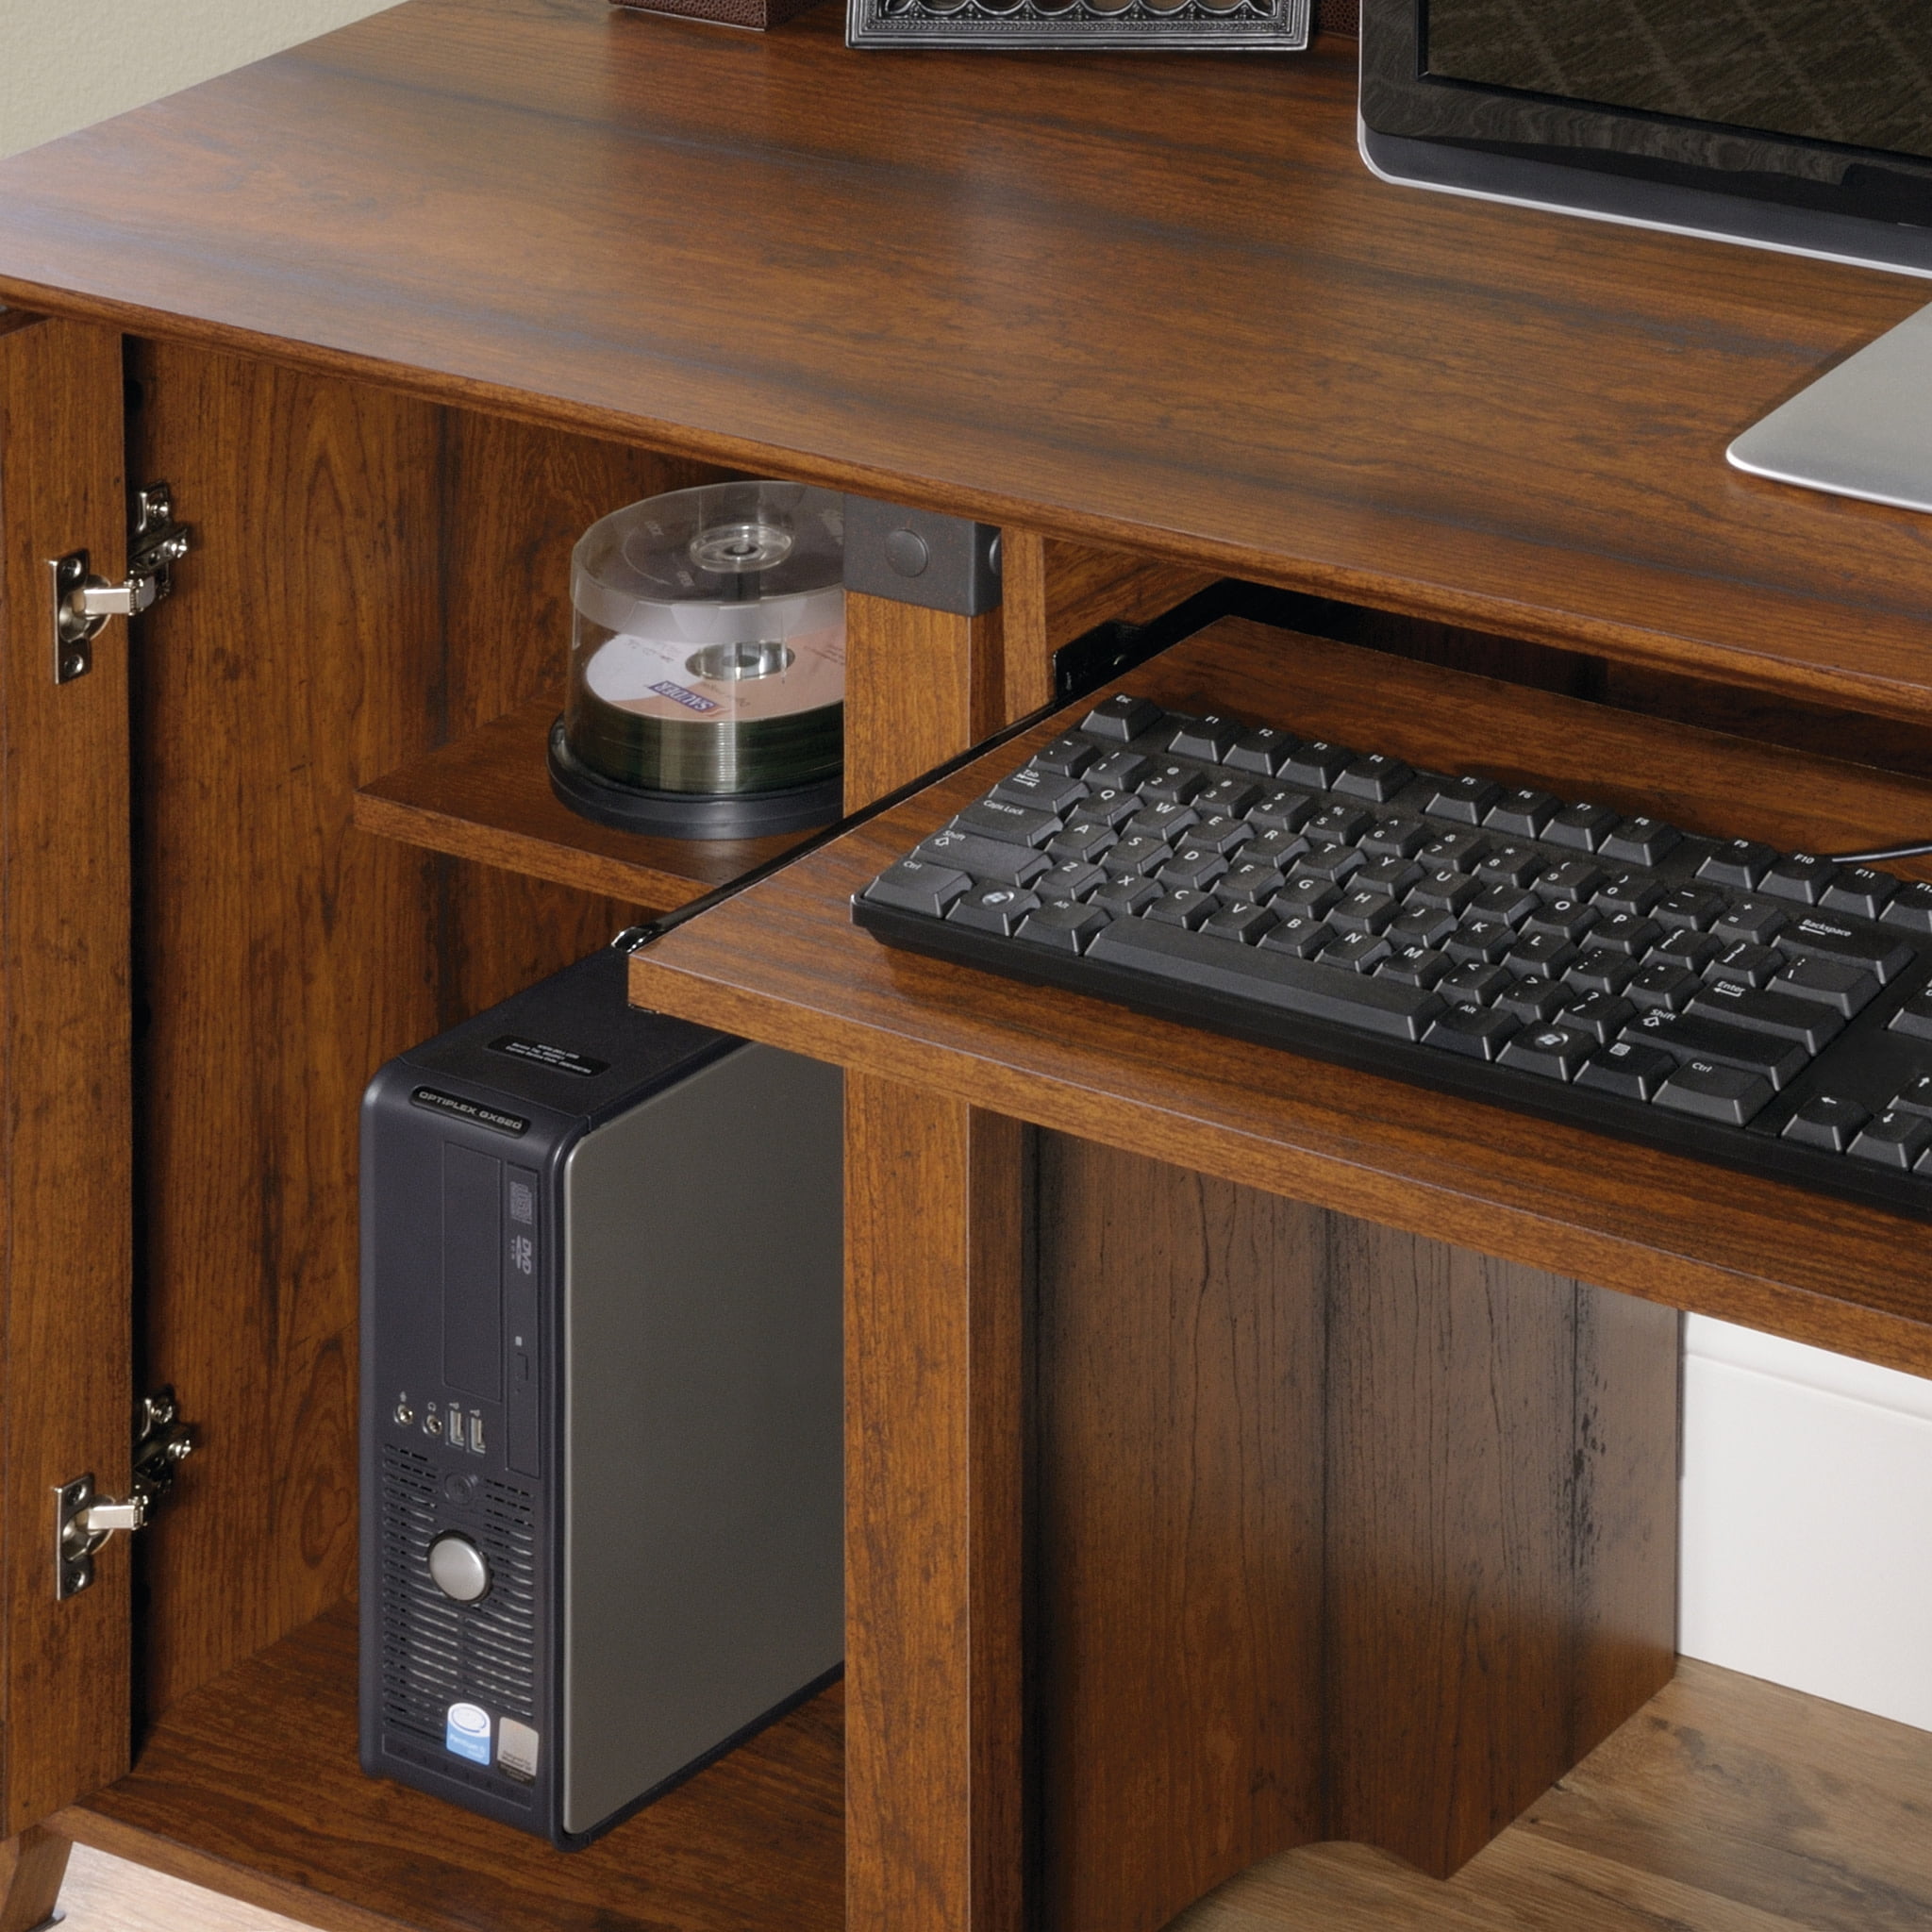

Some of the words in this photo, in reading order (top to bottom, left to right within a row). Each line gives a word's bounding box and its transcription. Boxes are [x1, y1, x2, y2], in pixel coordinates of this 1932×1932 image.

[654, 682, 715, 710] SAUDER
[1024, 769, 1039, 778] Tab
[983, 800, 1005, 812] Caps
[1005, 806, 1025, 816] Lock
[1156, 802, 1175, 813] W
[1208, 816, 1223, 825] E
[1074, 824, 1089, 834] A
[943, 830, 966, 841] Shift
[1264, 830, 1278, 840] R
[1128, 837, 1142, 846] S
[1324, 843, 1337, 853] T
[1184, 850, 1199, 860] D
[904, 860, 922, 870] Ctrl
[1062, 862, 1078, 872] Z
[1381, 857, 1395, 867] Y
[1240, 864, 1255, 873] F
[1117, 875, 1135, 886] X
[1436, 871, 1452, 881] U
[1547, 873, 1559, 881] 9
[1298, 879, 1314, 890] G
[1174, 891, 1189, 899] C
[1354, 892, 1372, 903] H
[1232, 903, 1248, 913] V
[1411, 908, 1425, 917] J
[1287, 918, 1302, 928] B
[1612, 914, 1627, 924] P
[1472, 922, 1489, 933] K
[1803, 919, 1853, 937] Backspace
[1344, 932, 1362, 943] N
[1530, 936, 1541, 946] L
[1404, 947, 1424, 958] M
[1718, 981, 1745, 993] Enter
[1459, 1005, 1476, 1014] Alt
[1651, 1008, 1676, 1021] Shift
[1692, 1062, 1712, 1073] Ctrl
[418, 1091, 476, 1115] OPTIPLEX
[522, 1237, 532, 1274] DVD
